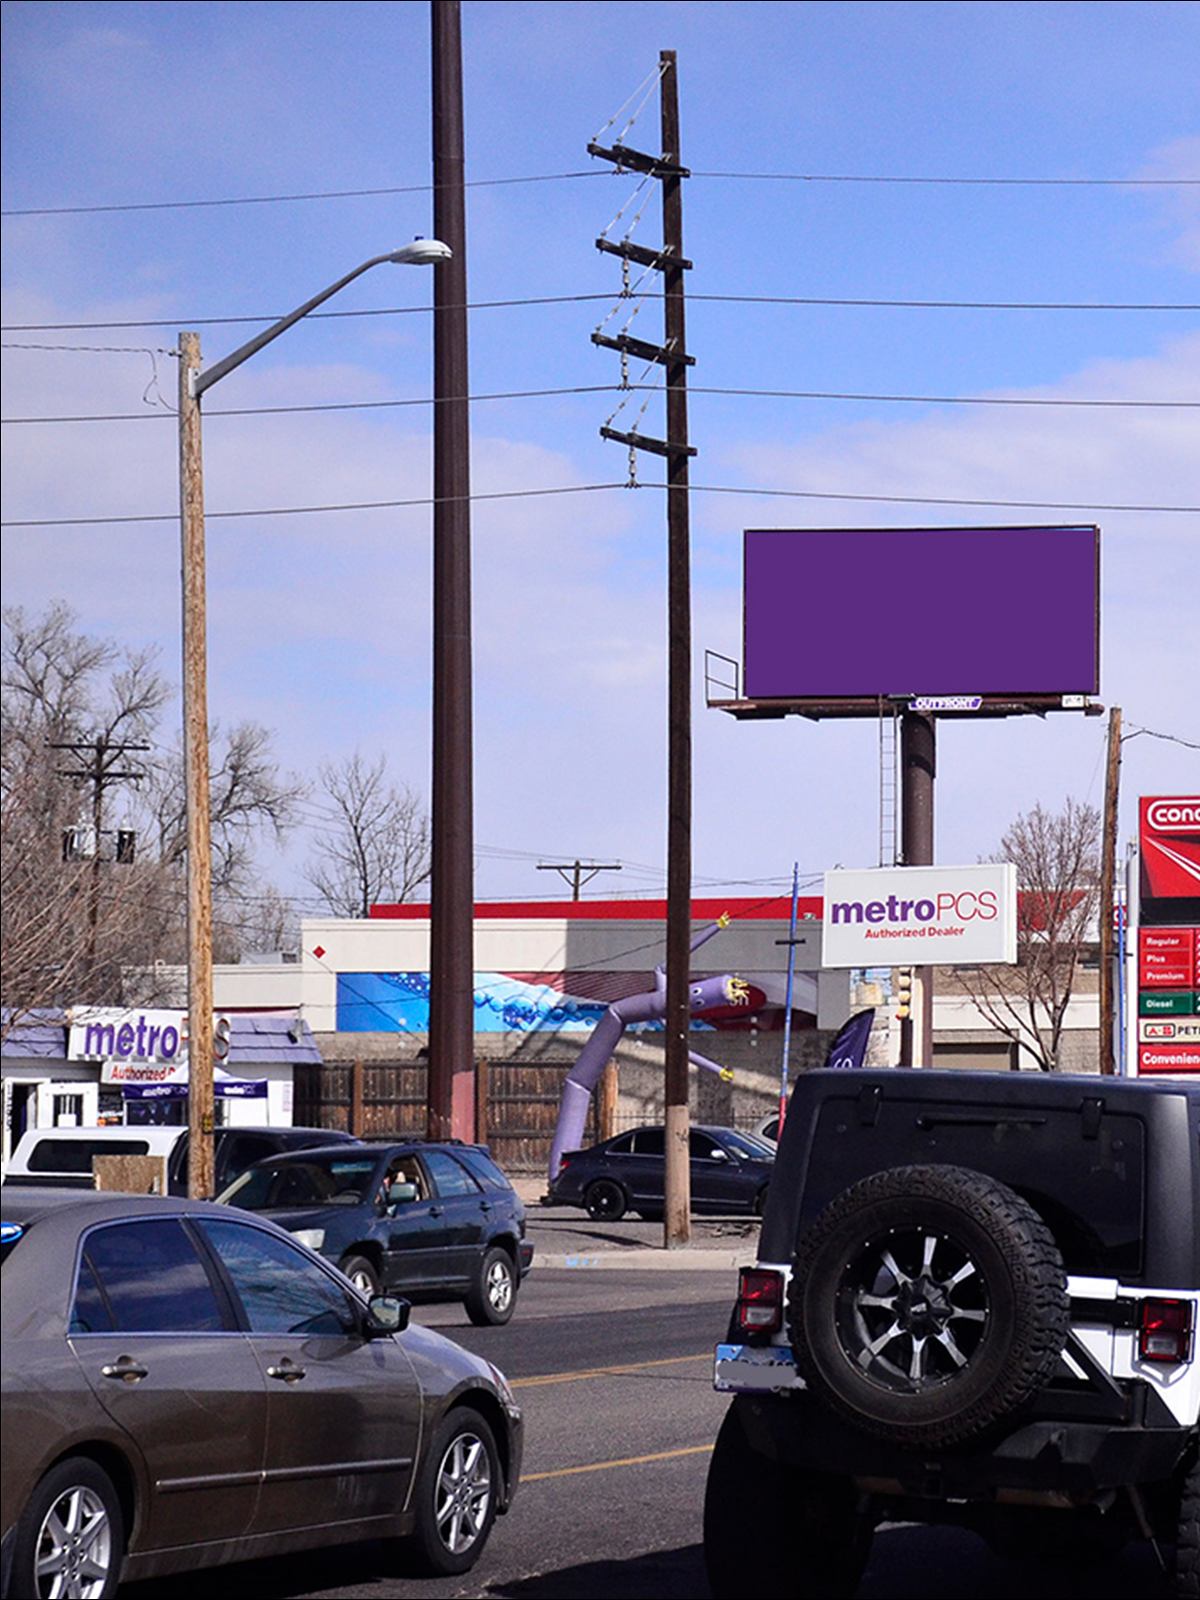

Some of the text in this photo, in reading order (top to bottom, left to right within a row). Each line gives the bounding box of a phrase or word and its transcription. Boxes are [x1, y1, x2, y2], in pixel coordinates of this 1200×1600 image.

[831, 891, 997, 924] metroPCS
[864, 926, 965, 939] Authorized Dealer
[1146, 937, 1179, 946] Regular
[1146, 954, 1166, 963] Plus
[1146, 971, 1185, 980] Premium
[1146, 999, 1174, 1008] Diesel
[110, 1065, 166, 1081] Authorized
